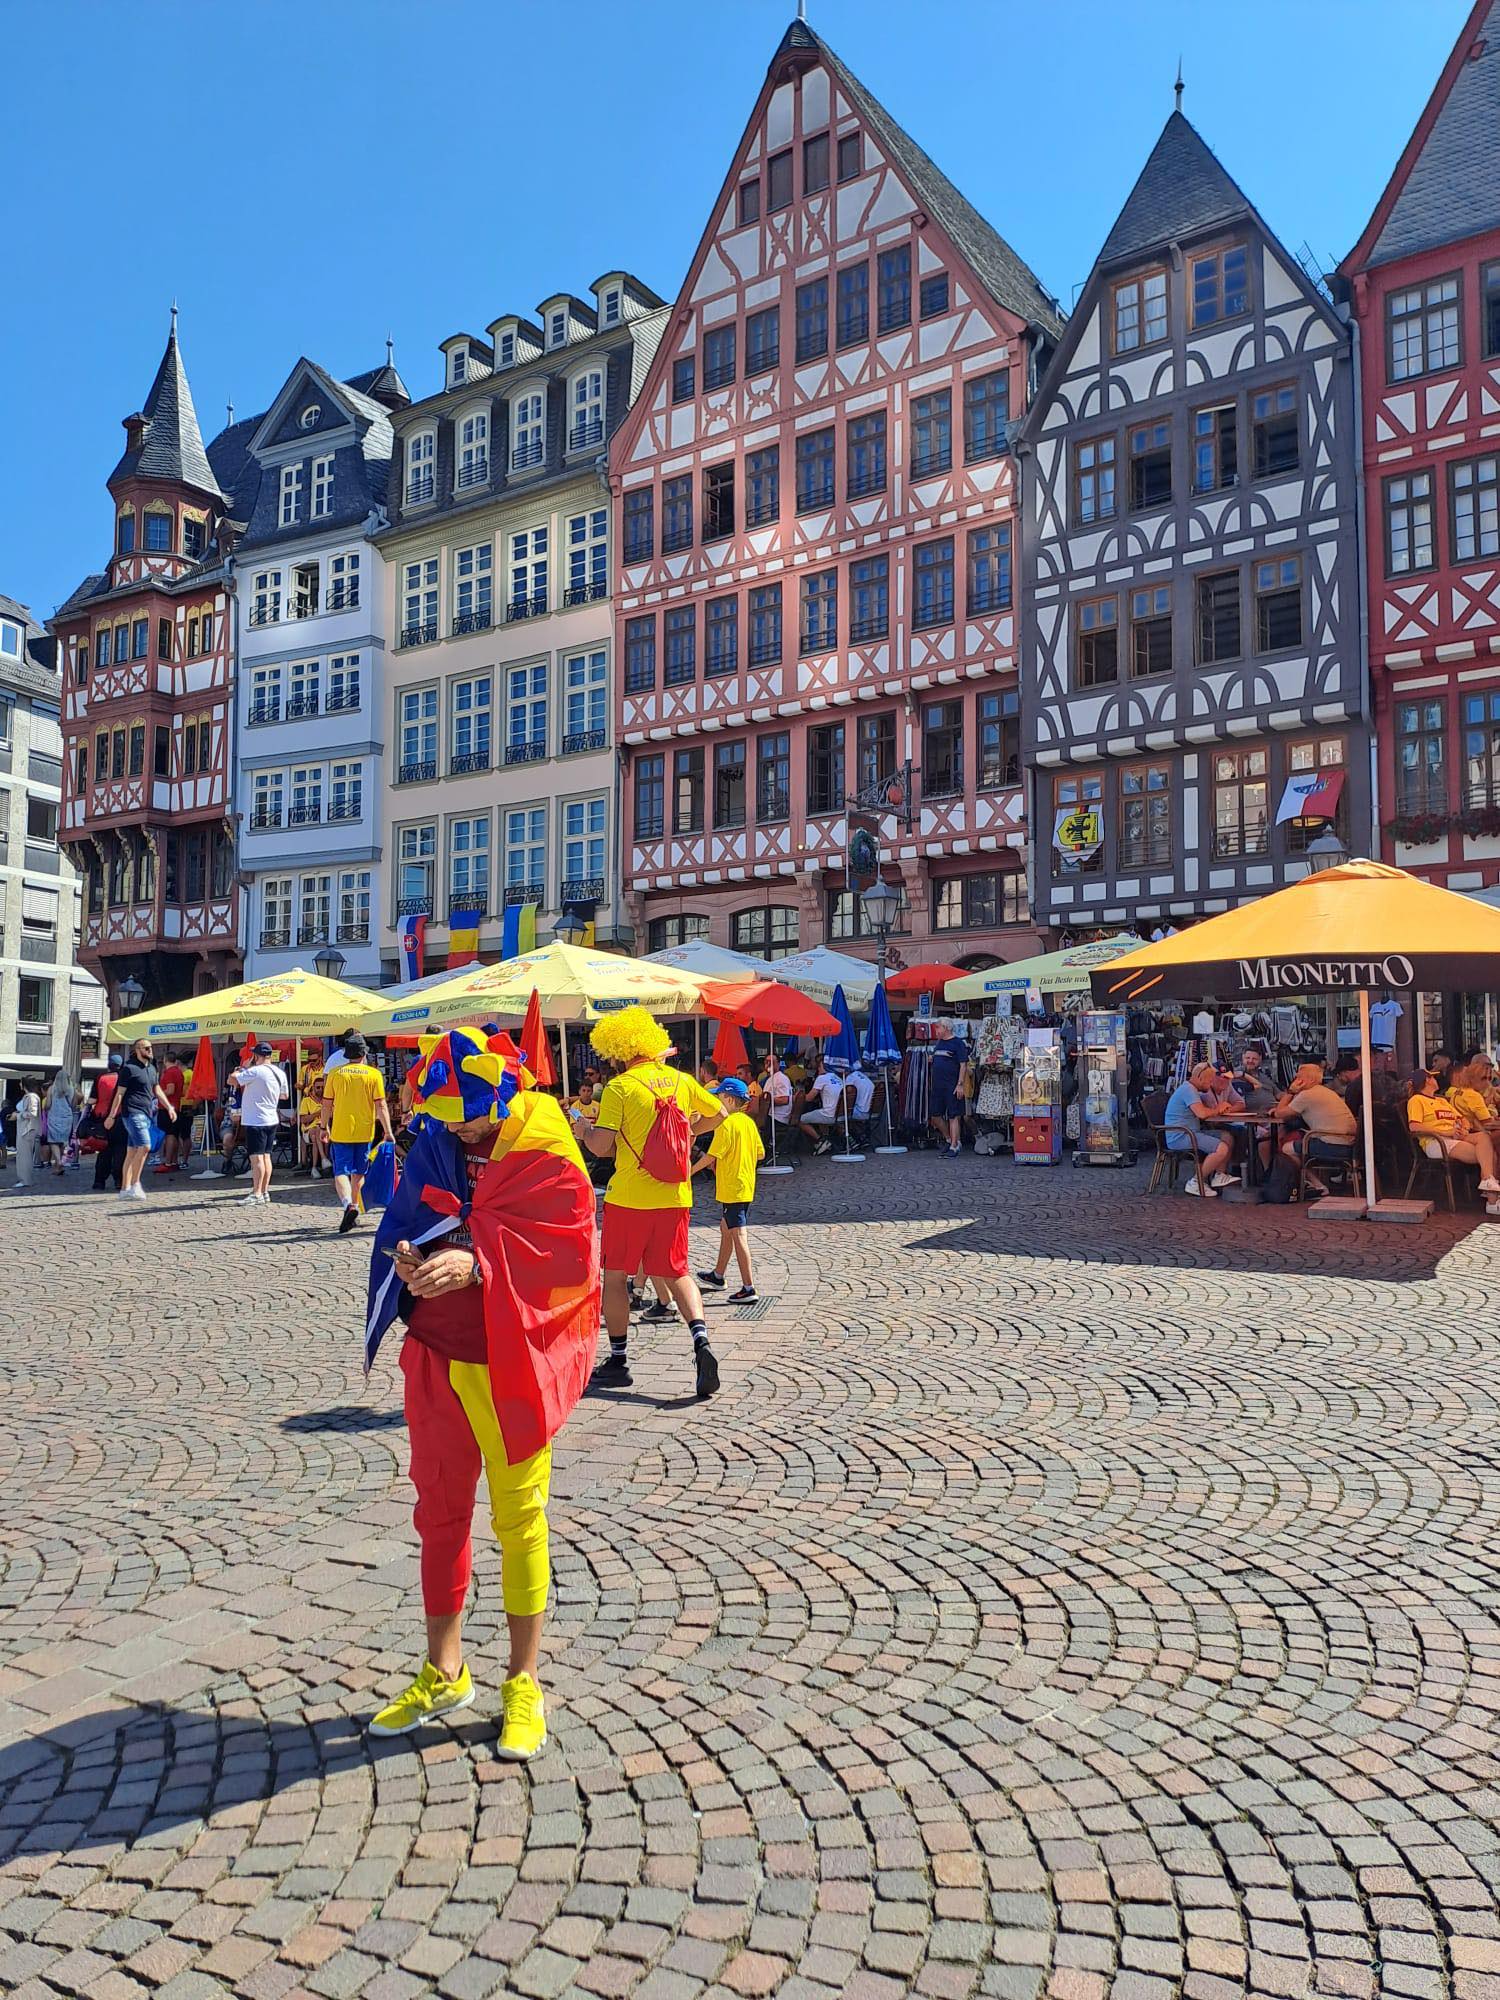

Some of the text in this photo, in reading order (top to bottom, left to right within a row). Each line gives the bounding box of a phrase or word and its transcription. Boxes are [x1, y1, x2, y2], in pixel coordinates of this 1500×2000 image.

[1236, 954, 1415, 990] MIONETTO
[988, 980, 1027, 990] POSSMANN
[1040, 977, 1053, 985] Das
[206, 1019, 219, 1028] Das
[253, 1017, 265, 1026] ein
[266, 1018, 285, 1028] Apfel
[286, 1018, 311, 1027] werden
[154, 1024, 195, 1033] POSSMANN
